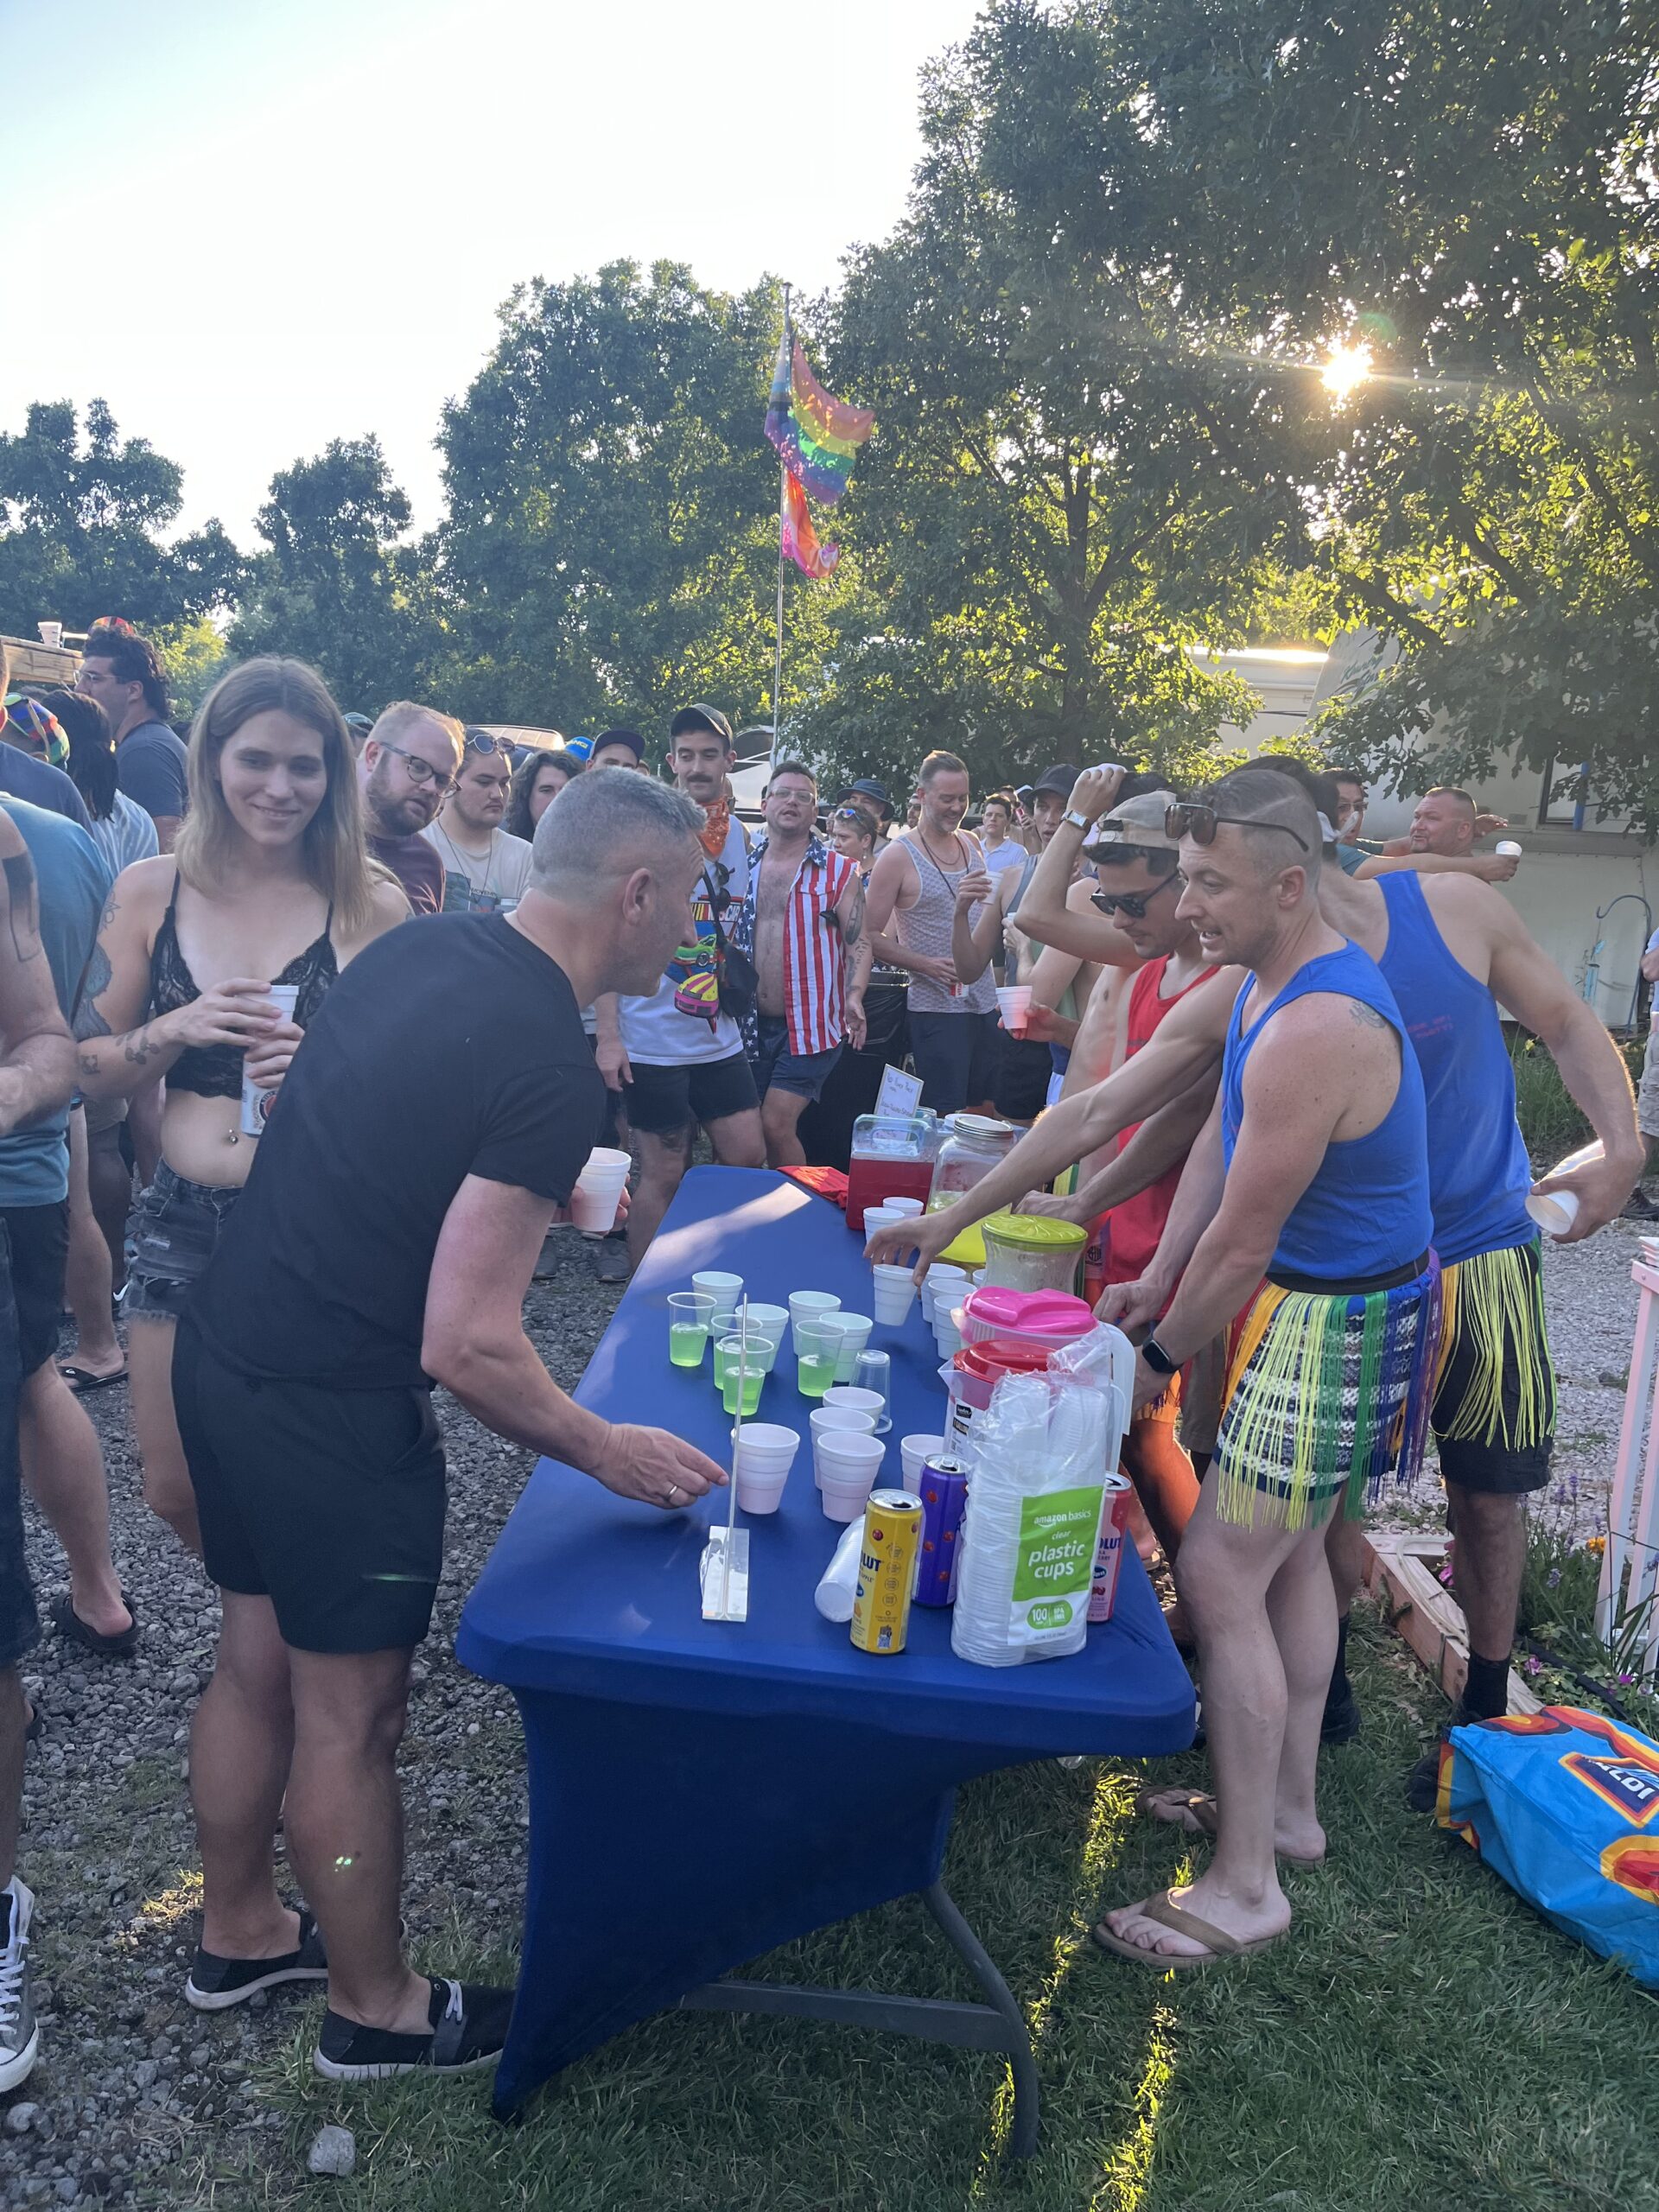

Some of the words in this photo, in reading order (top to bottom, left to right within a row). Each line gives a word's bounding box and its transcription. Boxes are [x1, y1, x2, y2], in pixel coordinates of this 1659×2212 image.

[1034, 1514, 1067, 1524] amazon
[1068, 1510, 1091, 1521] basics
[1052, 1530, 1071, 1540] clear
[1028, 1540, 1086, 1567] plastic
[1033, 1560, 1075, 1580] cups
[1032, 1608, 1047, 1622] 100
[1594, 1761, 1656, 1800] LDI
